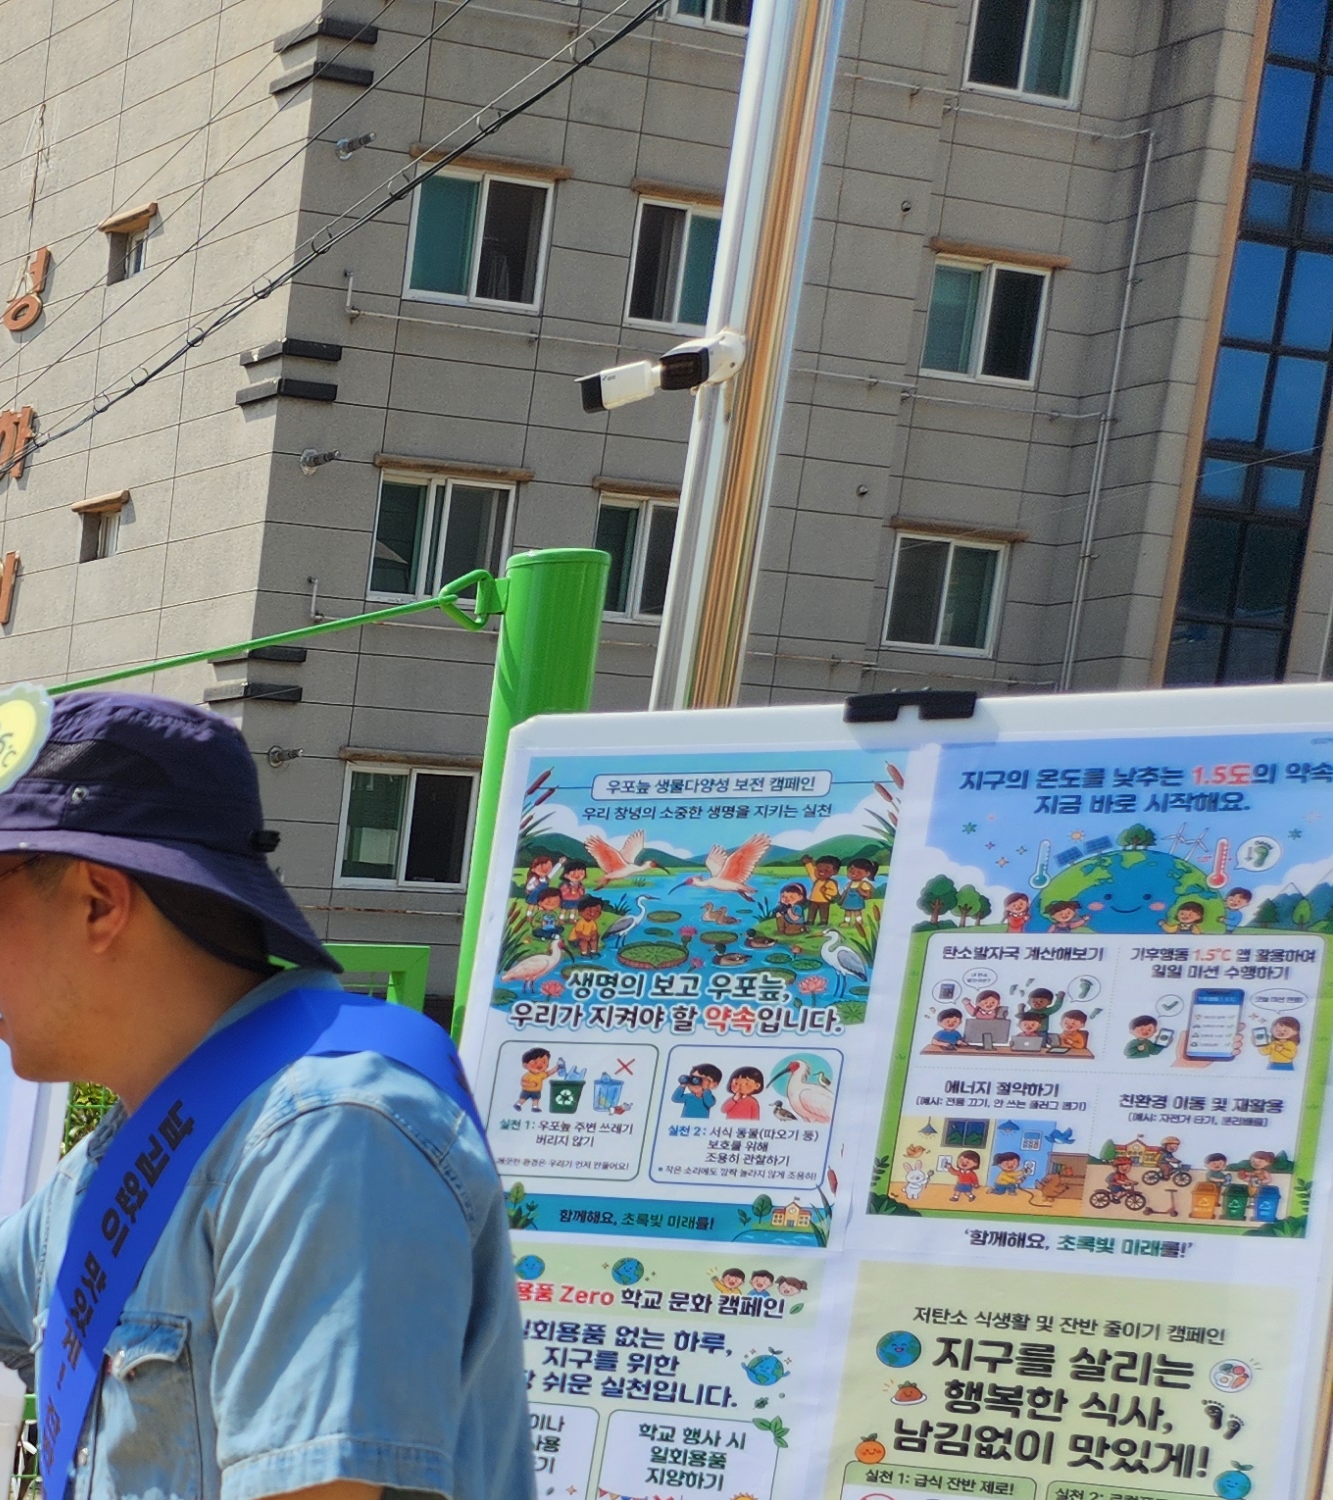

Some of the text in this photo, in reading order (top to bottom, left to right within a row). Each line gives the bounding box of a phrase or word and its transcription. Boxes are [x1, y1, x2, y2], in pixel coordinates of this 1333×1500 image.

[605, 776, 816, 794] 우포늪 생물다양성 보전 캠페인
[959, 769, 1030, 791] 지구의
[1035, 766, 1107, 789] 온도를
[1112, 765, 1185, 788] 낮추는
[1191, 763, 1277, 785] 1.5도의
[582, 803, 833, 820] 우리 창녕의 소중한 생명을 지키는 실천
[1033, 791, 1251, 815] 지금 바로 시작해요.
[942, 946, 1105, 962] 탄소발자국 계산해보기
[1129, 947, 1190, 962] 기후행동
[1236, 948, 1251, 963] 앱
[1255, 949, 1316, 963] 활용하여
[1151, 964, 1290, 980] 일일 미션 수행하기
[567, 973, 791, 1003] 생명의 보고 우포늪,
[509, 1004, 843, 1033] 우리가 지켜야 할 약속입니다.
[944, 1080, 1060, 1098] 에너지 절약하기
[1119, 1093, 1285, 1114] 친환경 이동 및 재활용
[498, 1119, 633, 1135] 실천 우포늪 주변 쓰레기
[667, 1124, 733, 1138] 실천 서식
[1159, 1113, 1191, 1124] 자전거
[535, 1134, 594, 1148] 버리지 않기
[706, 1139, 769, 1153] 보호를 위해
[704, 1152, 790, 1167] 조용히 관찰하기
[100, 1098, 195, 1259] 남김없이
[558, 1209, 715, 1230] 함께해요, 초록빛 미래를!
[1056, 1234, 1115, 1255] 초록빛
[558, 1284, 615, 1306] Zero
[620, 1287, 663, 1311] 학교
[668, 1292, 713, 1314] 문화
[717, 1293, 786, 1319] 캠페인
[912, 1306, 1227, 1347] 저탄소 식생활 및 잔반 줄이기 캠페인
[614, 1325, 666, 1351] 없는
[673, 1329, 733, 1357] 하루,
[541, 1346, 681, 1377] 지구를 위한
[930, 1334, 1196, 1391] 지구를 살리는
[541, 1371, 594, 1396] 쉬운
[599, 1377, 739, 1410] 실천입니다.
[942, 1377, 1176, 1435] 행복한 식사,
[638, 1422, 747, 1450] 학교 행사 시
[891, 1415, 1211, 1479] 남김없이 맛있게!
[648, 1444, 728, 1470] 일회용품
[644, 1466, 725, 1492] 지양하기
[864, 1467, 1014, 1496] 실천 1: 급식 잔반 제로!
